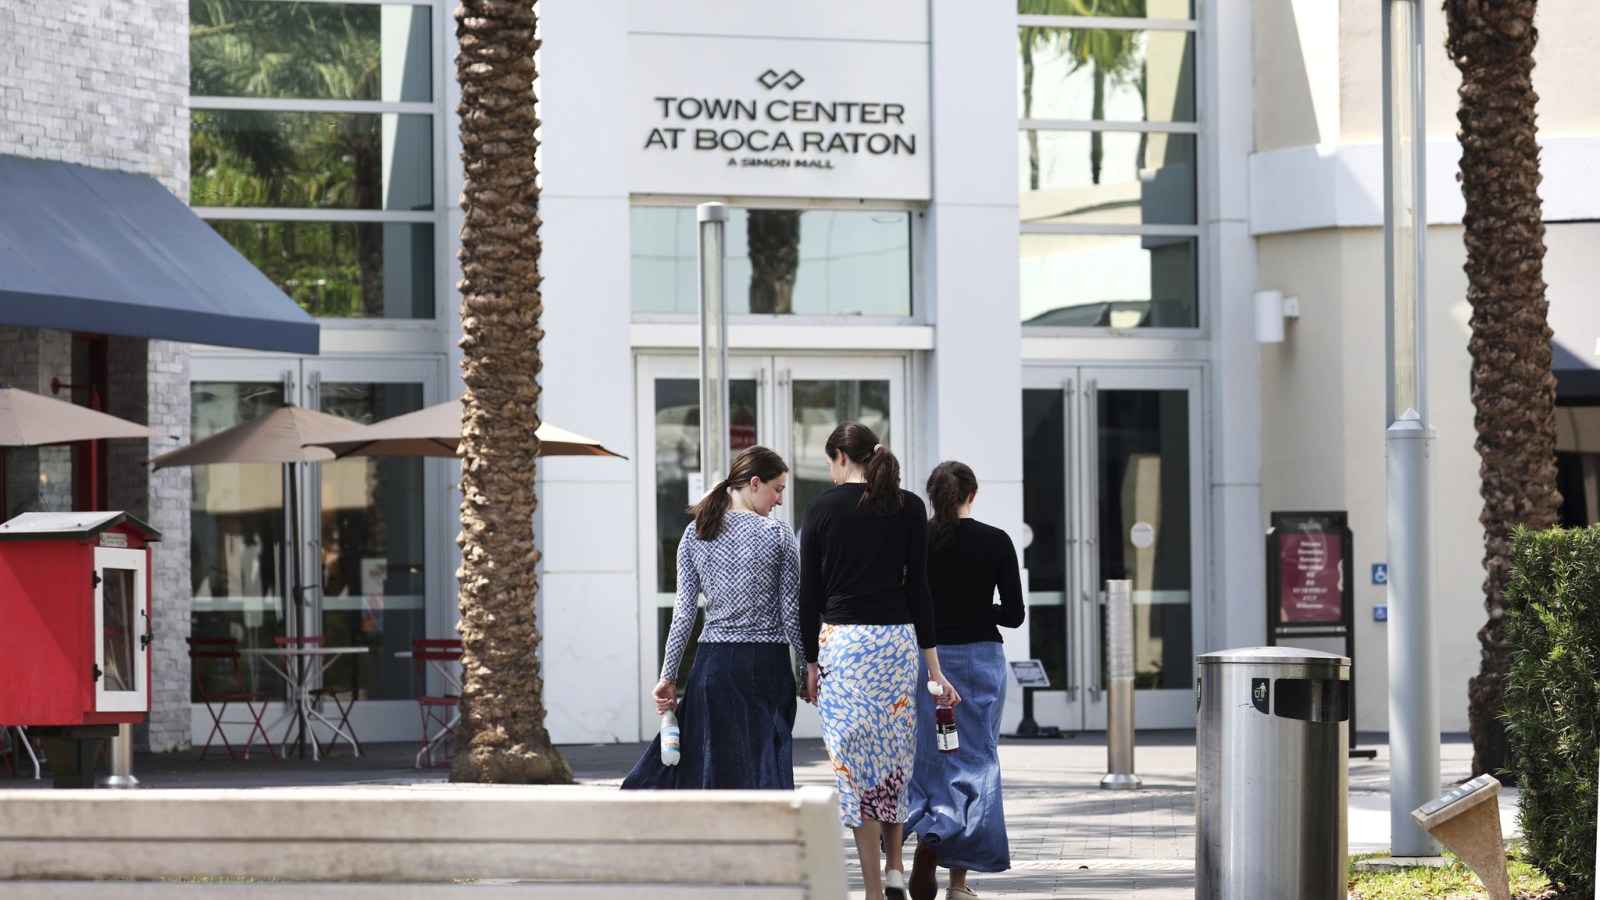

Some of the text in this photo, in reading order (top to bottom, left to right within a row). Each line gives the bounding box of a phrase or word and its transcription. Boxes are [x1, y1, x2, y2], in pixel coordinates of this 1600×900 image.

[655, 97, 905, 124] TOWN CENTER
[644, 128, 916, 155] AT BOCA RATON
[726, 157, 834, 169] A SIMON MALL
